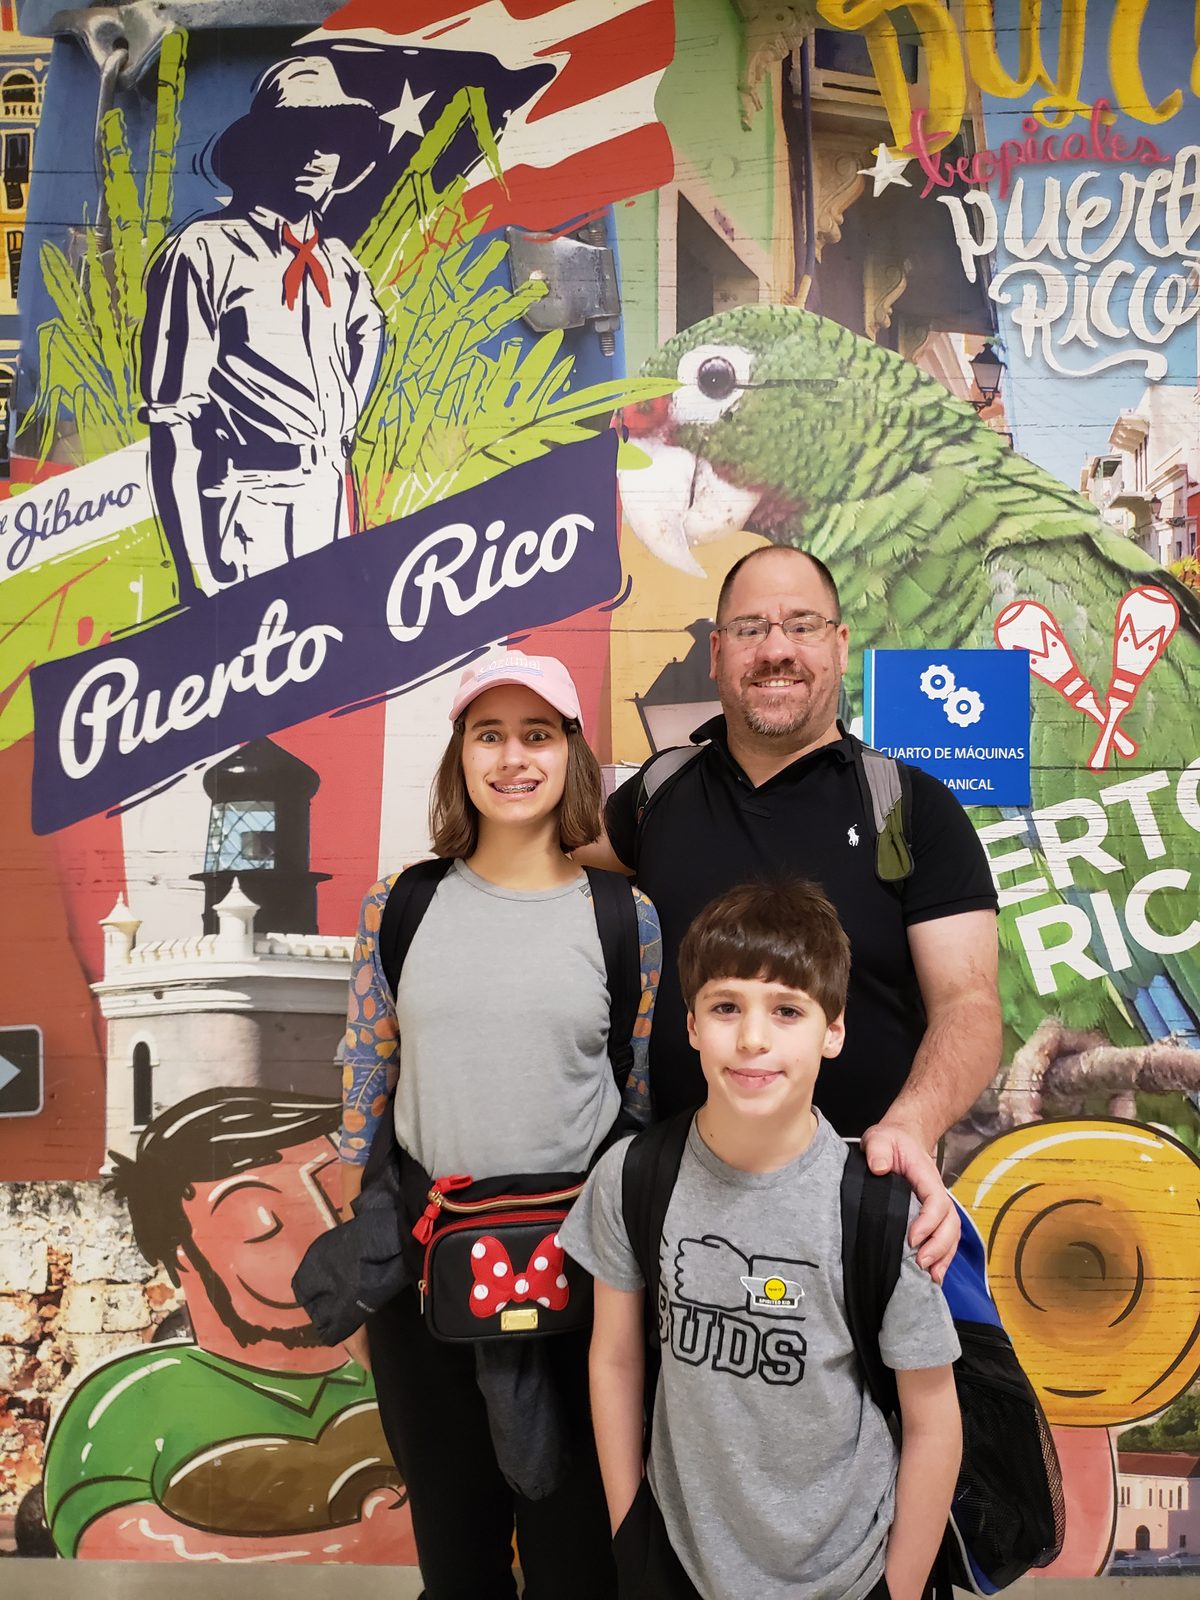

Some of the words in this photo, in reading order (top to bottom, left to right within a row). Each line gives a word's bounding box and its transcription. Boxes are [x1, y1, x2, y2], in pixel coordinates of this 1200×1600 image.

[816, 0, 1200, 160] Dulc
[903, 97, 1173, 199] tropicales
[936, 145, 1200, 284] puert
[6, 483, 141, 571] Jíbaro
[58, 598, 343, 780] Puerto
[386, 513, 596, 642] Rico
[934, 747, 951, 759] DE
[954, 745, 1025, 760] MÁQUINAS
[943, 778, 995, 790] ANICAL
